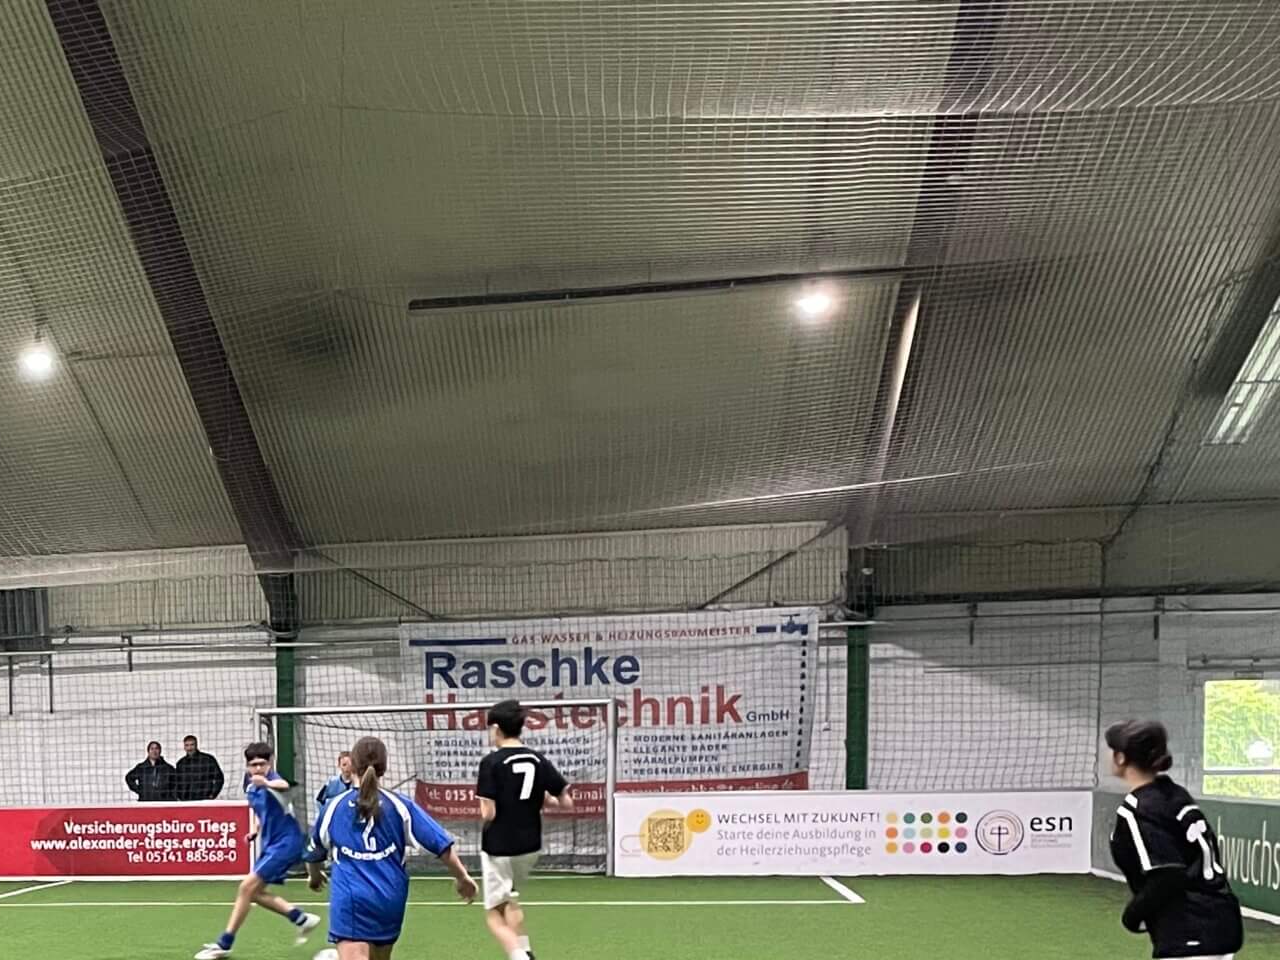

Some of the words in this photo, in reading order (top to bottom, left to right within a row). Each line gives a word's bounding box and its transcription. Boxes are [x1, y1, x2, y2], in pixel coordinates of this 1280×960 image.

[425, 647, 640, 689] Raschke
[426, 686, 743, 731] Hastechnik
[746, 709, 790, 722] GmbH
[512, 762, 535, 800] 7
[717, 813, 781, 824] WECHSEL
[784, 813, 808, 823] MIT
[812, 812, 880, 823] ZUKUNFT!
[1030, 816, 1073, 832] esn
[64, 820, 195, 838] Versicherungsbüro
[198, 820, 236, 838] Tiegs
[717, 829, 753, 840] Starte
[756, 829, 790, 840] deine
[792, 829, 861, 842] Ausbildung
[865, 829, 877, 839] in
[30, 836, 236, 853] www.alexander-tiegs.ergo.de
[717, 845, 737, 856] der
[740, 843, 871, 858] Heilerziehungspflege
[127, 851, 143, 863] Tel
[146, 851, 182, 862] 05141
[186, 850, 236, 862] 88568-0
